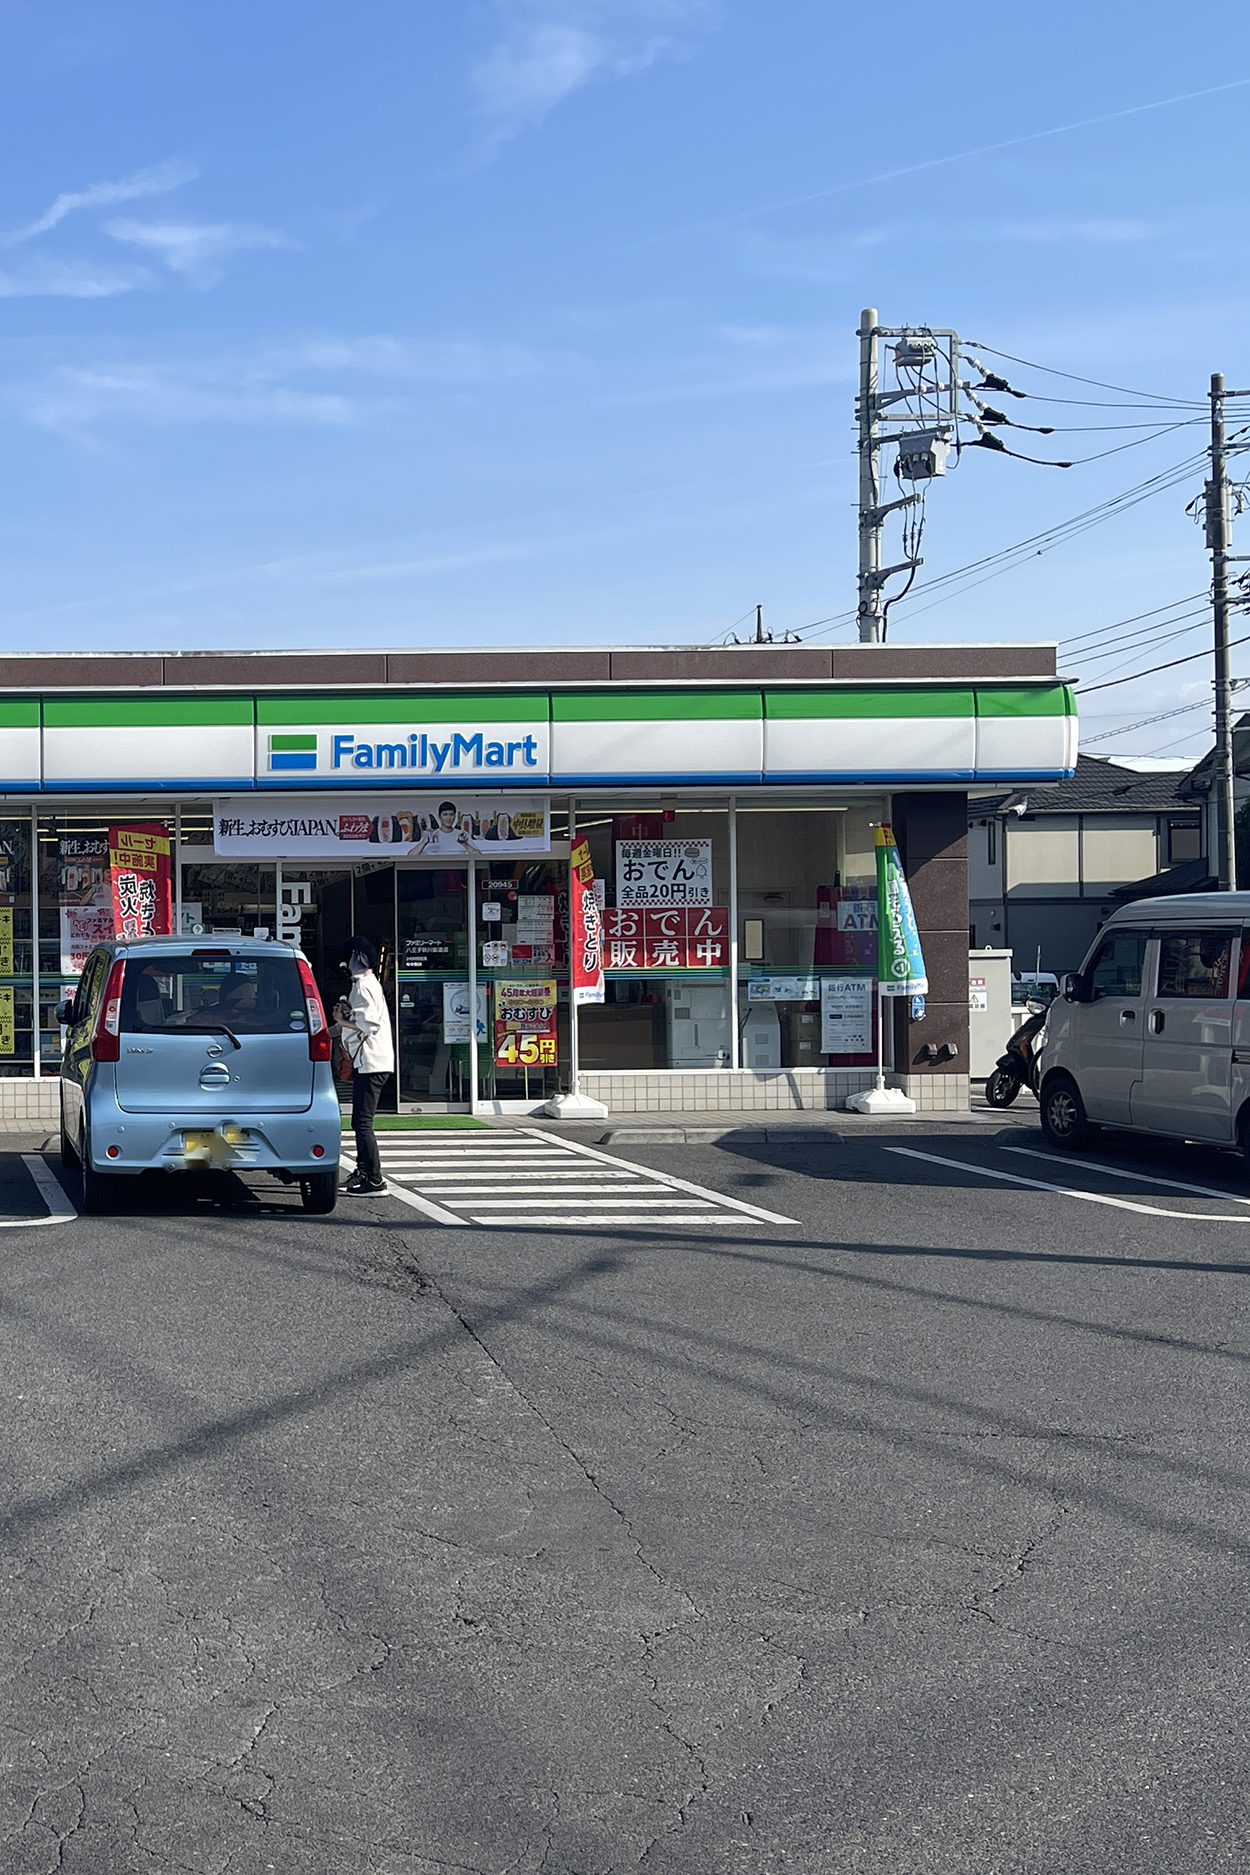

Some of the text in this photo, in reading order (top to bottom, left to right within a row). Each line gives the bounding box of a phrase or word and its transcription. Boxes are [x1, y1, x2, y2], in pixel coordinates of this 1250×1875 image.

[333, 732, 538, 772] FamilyMart
[622, 848, 681, 858] 毎週金曜日!!
[623, 860, 695, 881] おでん
[119, 875, 138, 917] 炭火
[583, 891, 598, 972] 焼きとり
[609, 909, 723, 937] おでん
[610, 939, 722, 967] 販売中
[501, 1007, 552, 1020] おむすび
